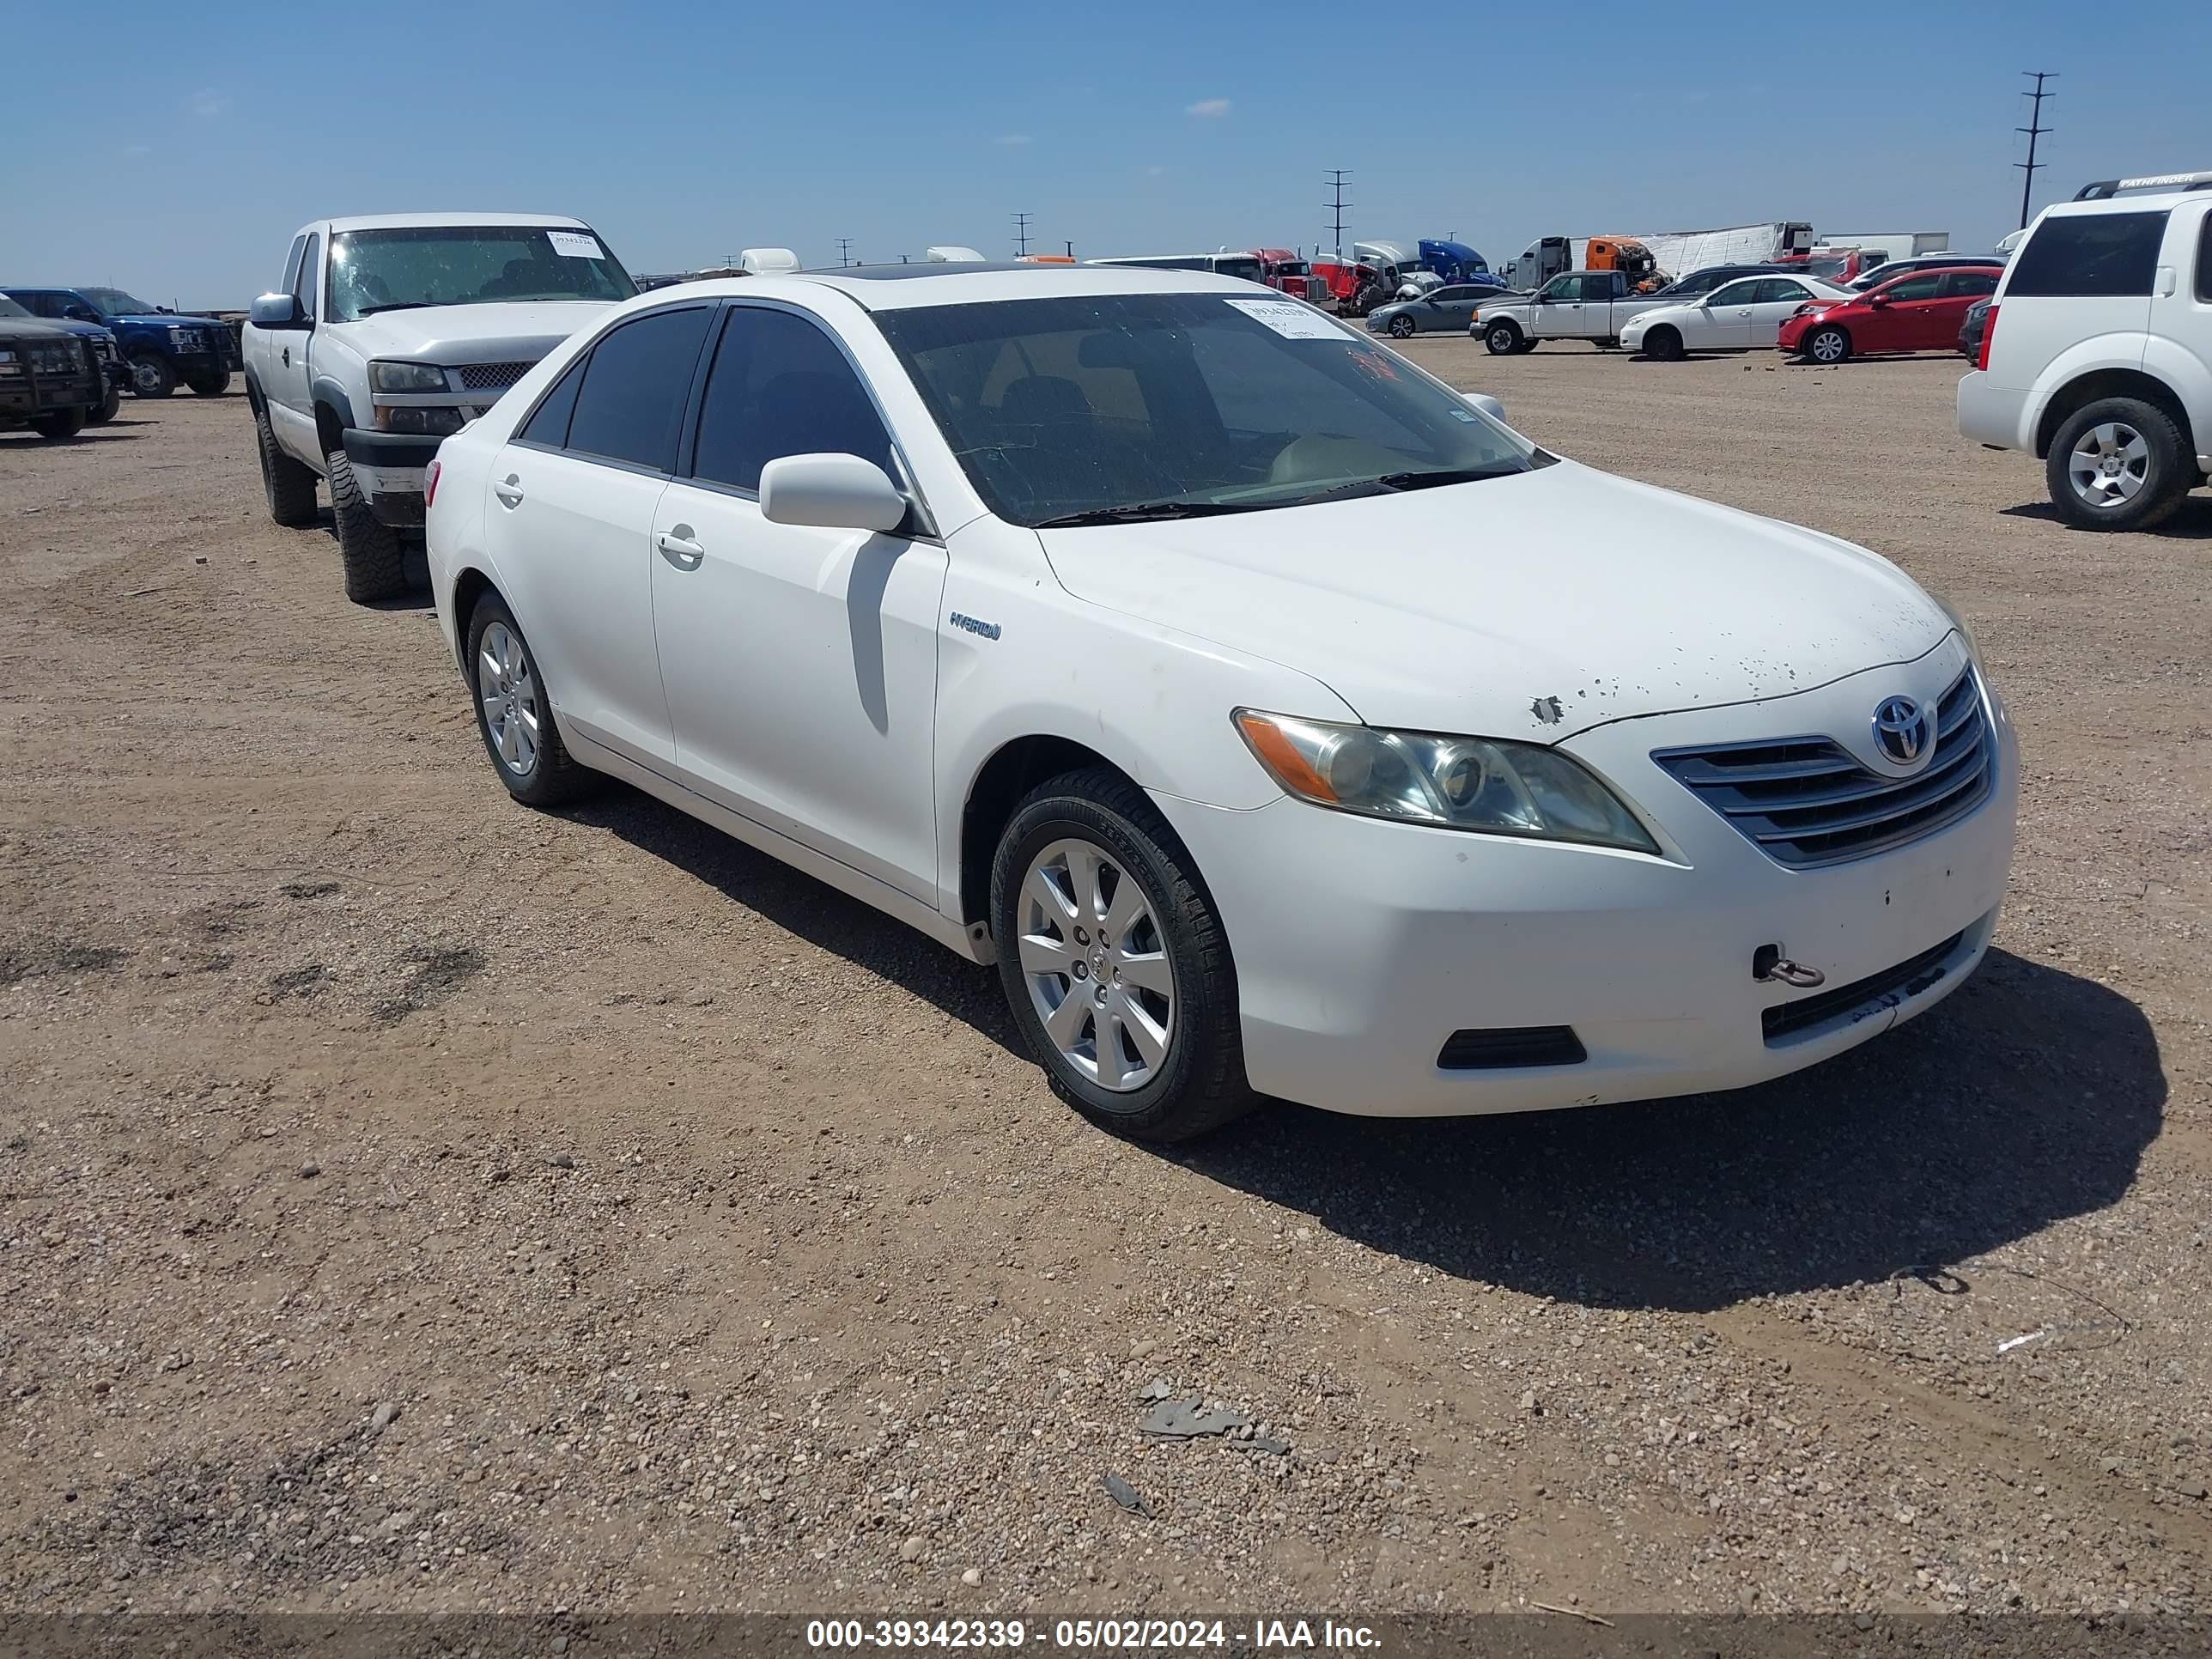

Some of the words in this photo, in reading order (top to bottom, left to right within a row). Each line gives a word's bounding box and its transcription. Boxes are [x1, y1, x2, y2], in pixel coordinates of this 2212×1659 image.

[2120, 174, 2197, 187] PATHFINDER
[1248, 307, 1310, 317] 39342339
[950, 611, 994, 639] HYBRID
